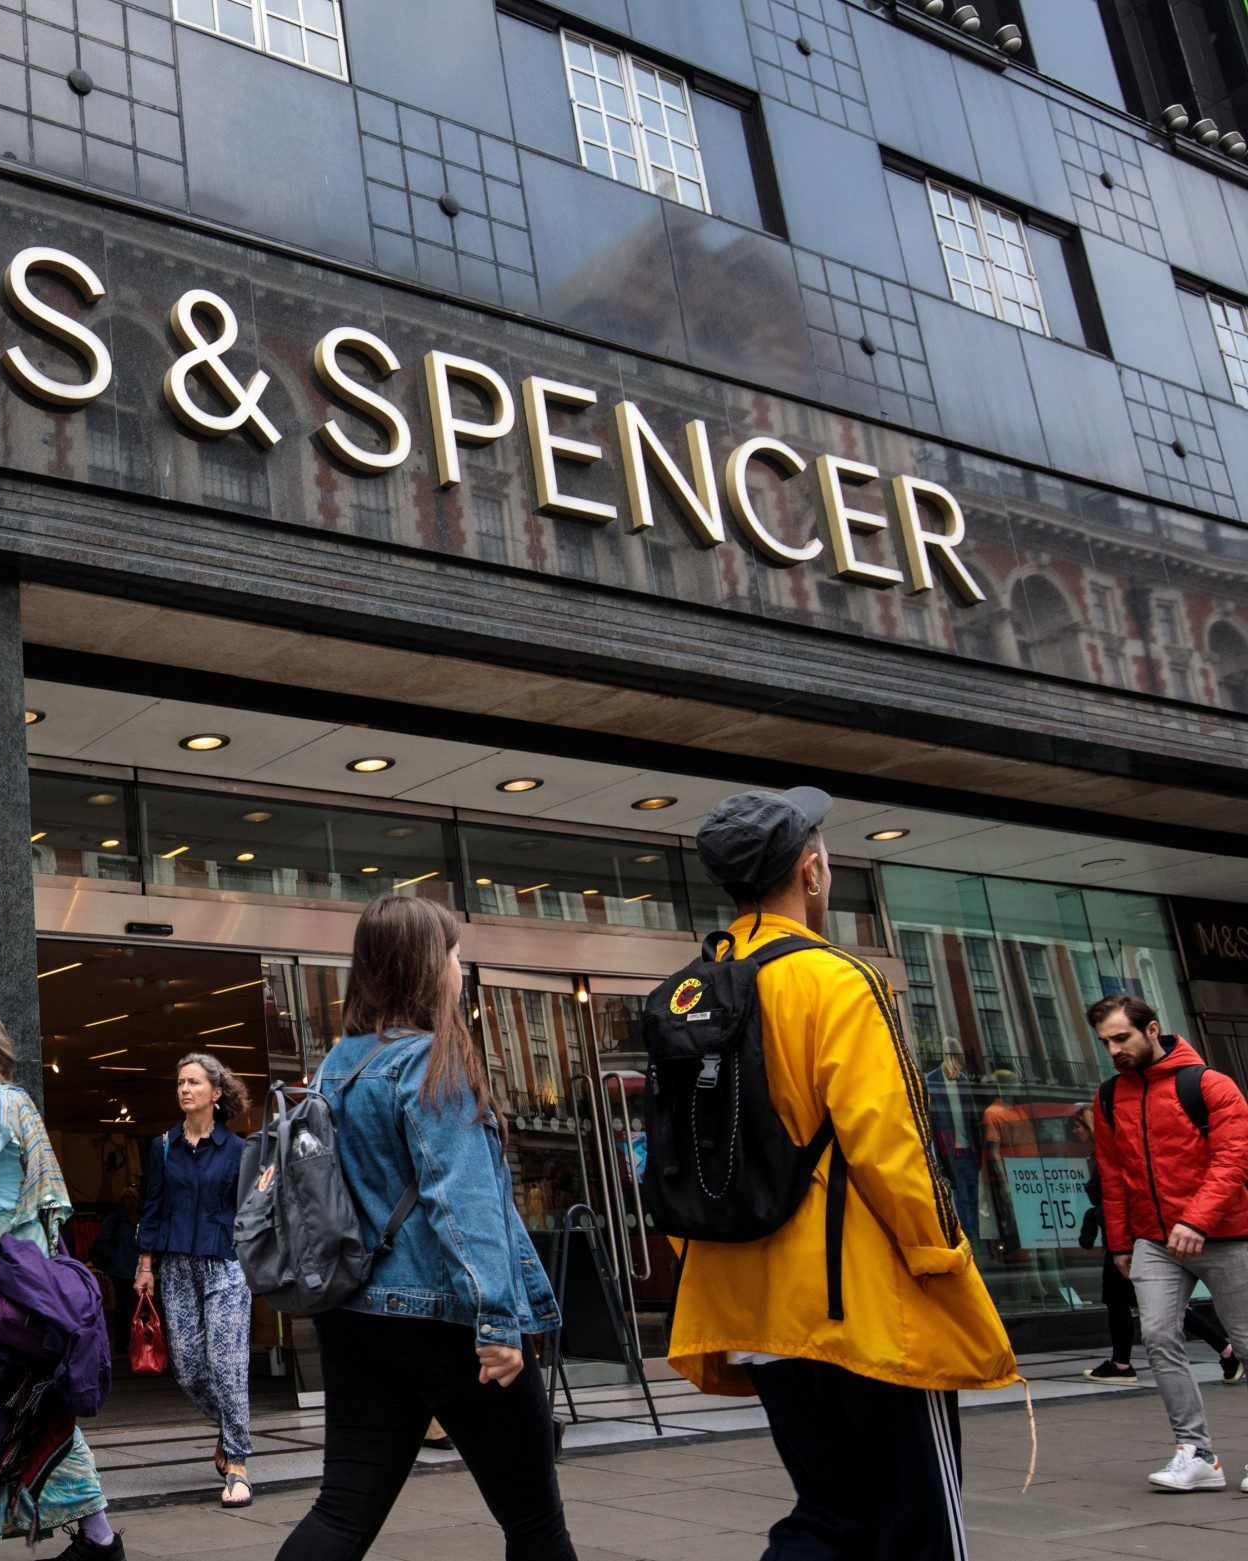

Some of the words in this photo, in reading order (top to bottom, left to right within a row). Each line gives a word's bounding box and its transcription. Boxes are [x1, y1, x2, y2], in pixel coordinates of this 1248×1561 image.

[162, 288, 283, 450] &
[312, 326, 986, 603] SPENCER
[1195, 922, 1248, 959] M&S
[674, 980, 700, 997] PLANET
[1013, 1169, 1039, 1181] 100%
[1044, 1169, 1085, 1181] COTTON
[1016, 1183, 1043, 1194] POLO
[1039, 1200, 1076, 1230] £15
